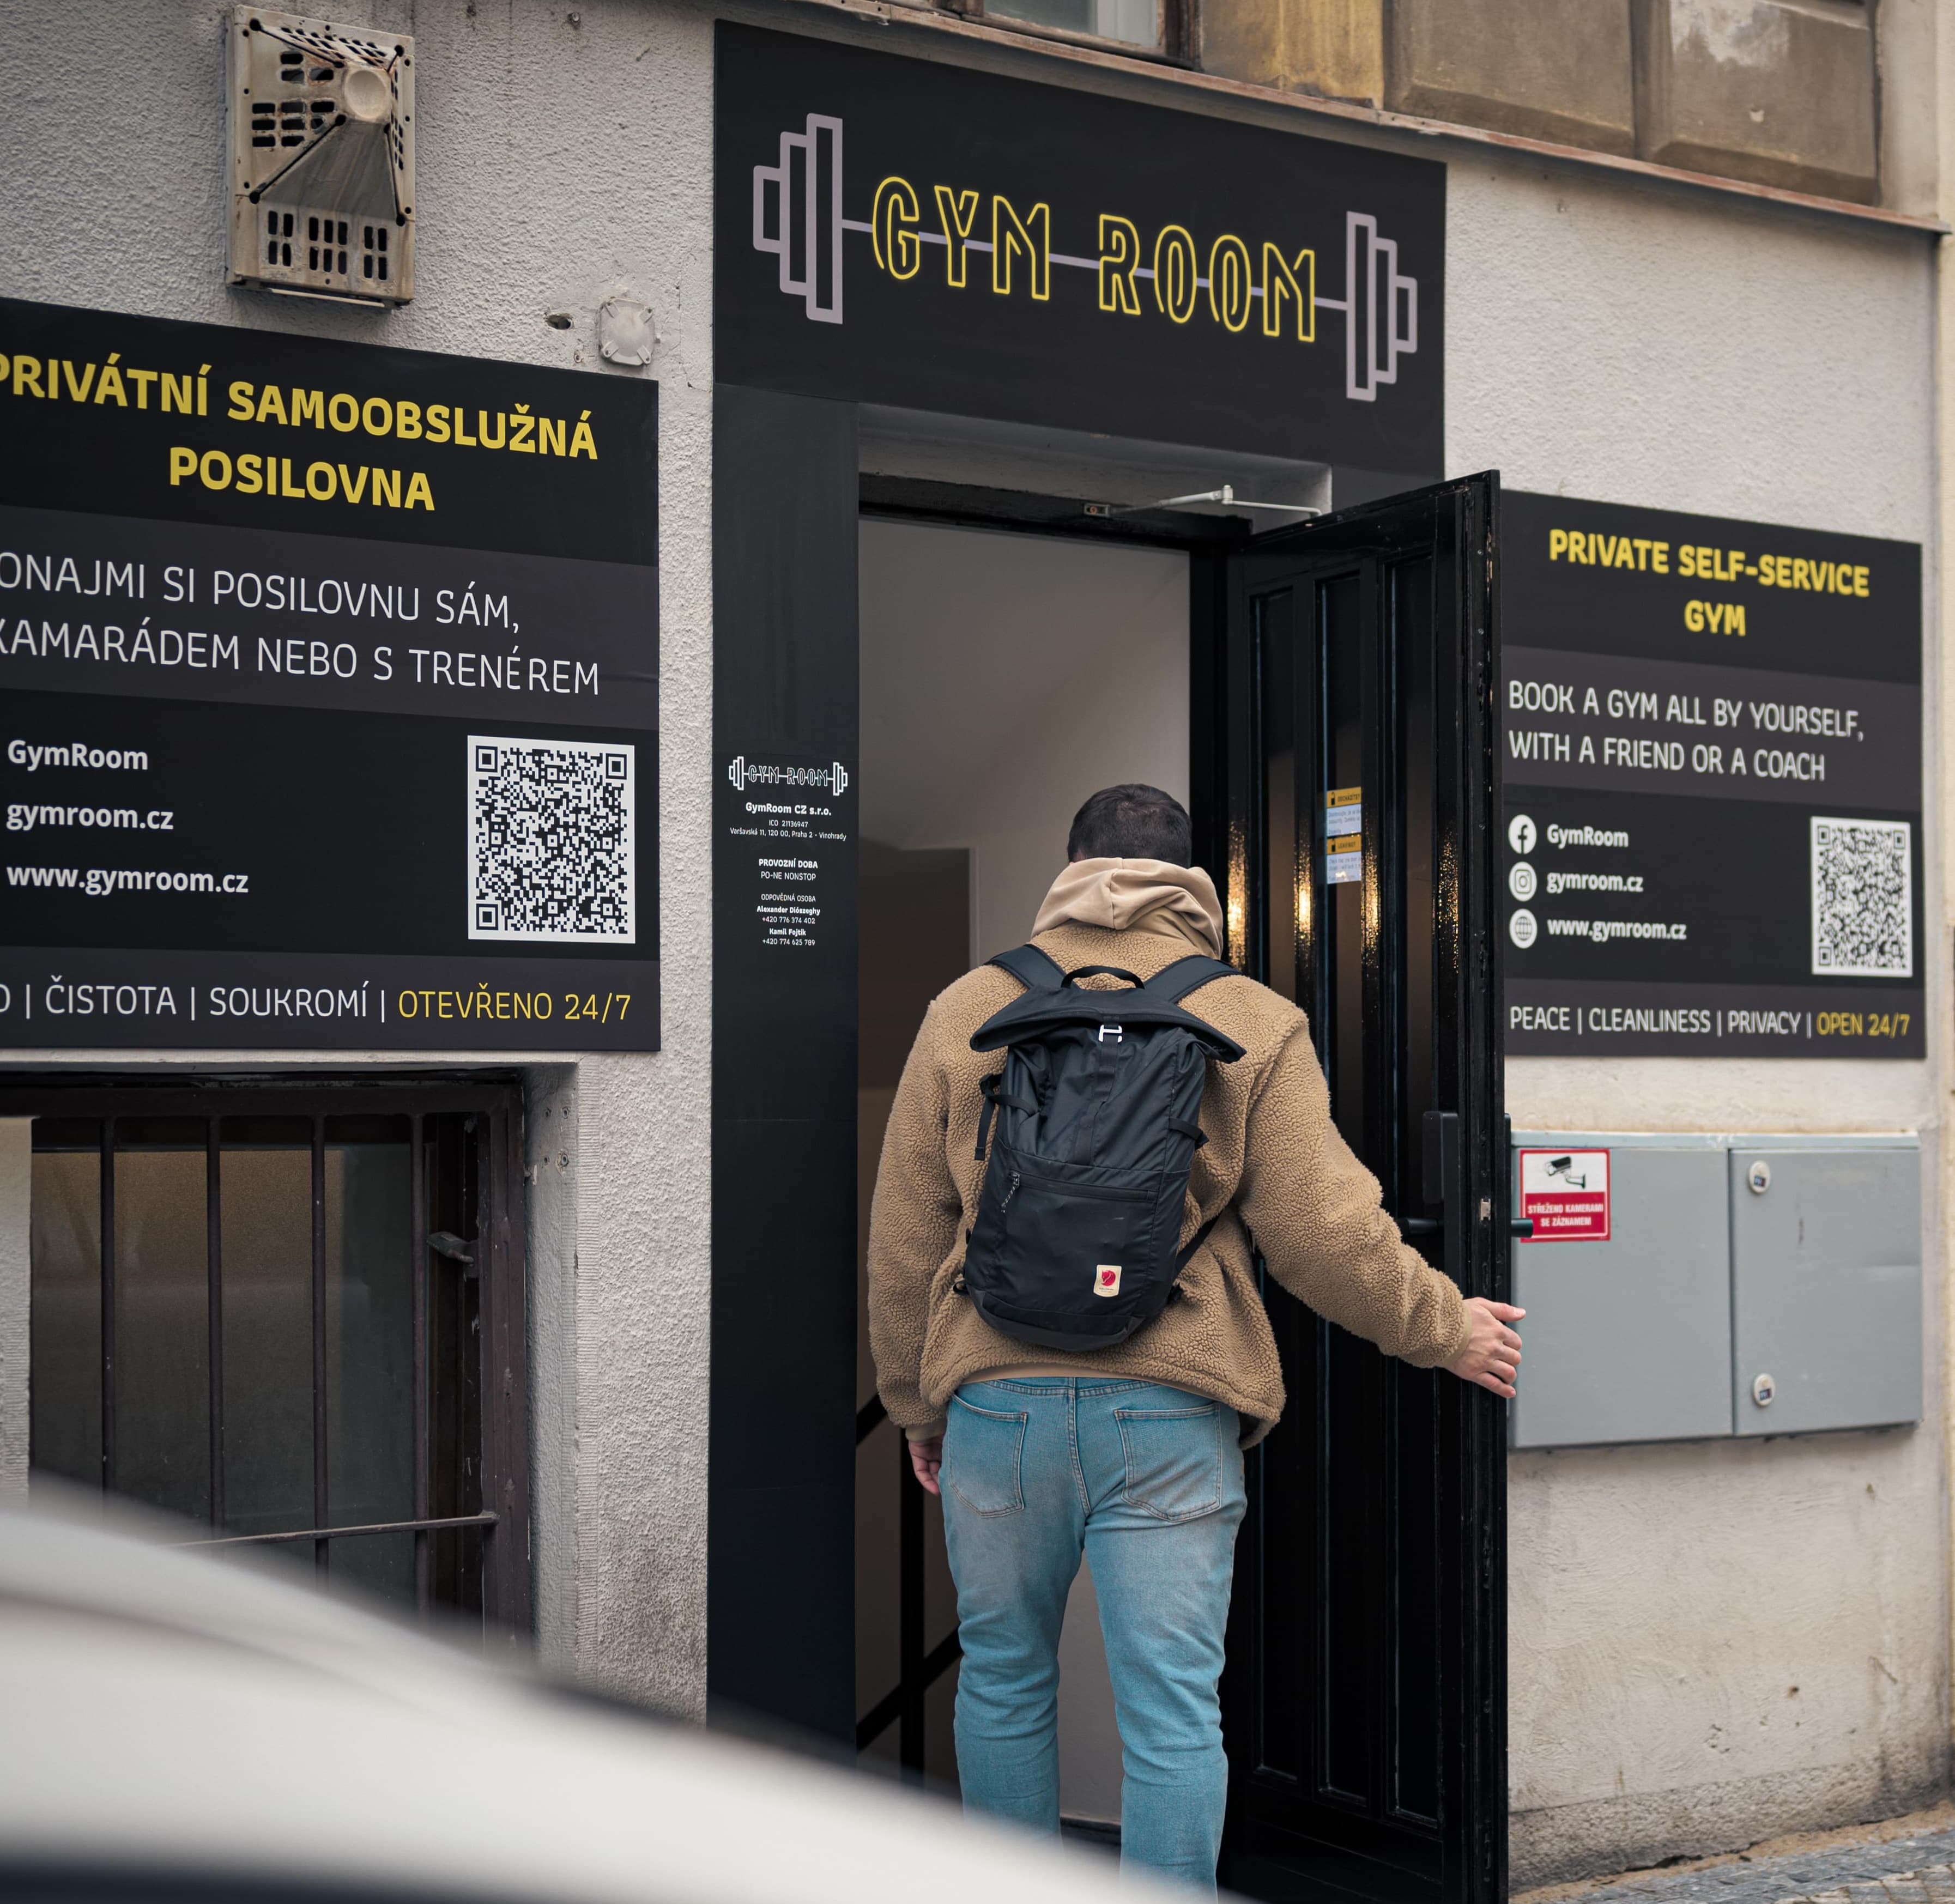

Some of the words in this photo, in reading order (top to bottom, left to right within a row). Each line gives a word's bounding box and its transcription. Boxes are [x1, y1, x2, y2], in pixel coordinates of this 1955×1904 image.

[872, 177, 1050, 301] GYM
[1099, 214, 1315, 342] ROOM
[228, 381, 597, 459] SAMOOBSLUŽNÁ
[171, 447, 434, 510] POSILOVNA
[1550, 529, 1669, 573] PRIVATE
[1679, 545, 1869, 597] SELF-SERVICE
[164, 567, 193, 602] SI
[214, 571, 418, 620] POSILOVNU
[437, 581, 518, 633] SÁM,
[1685, 601, 1745, 636] GYM
[258, 638, 356, 677] NEBO
[374, 647, 392, 680] S
[409, 646, 598, 695] TRENÉREM
[1510, 681, 1575, 713] BOOK
[1583, 688, 1599, 715] A
[1608, 689, 1657, 720] GYM
[1666, 695, 1706, 725] ALL
[1714, 699, 1742, 726] BY
[1750, 702, 1863, 741] YOURSELF,
[8, 740, 148, 771] GymRoom
[1509, 730, 1569, 761] WITH
[1579, 736, 1595, 763] A
[1604, 737, 1684, 770] FRIEND
[1692, 744, 1723, 773] OR
[1731, 748, 1746, 774] A
[1754, 749, 1824, 780] COACH
[748, 765, 779, 784] GYM
[787, 767, 828, 787] ROOM
[7, 804, 173, 831] gymroom.cz
[746, 802, 791, 814] GymRoom
[795, 805, 807, 814] CZ
[819, 833, 846, 841] Vinohrady
[1547, 824, 1628, 848] GymRoom
[759, 859, 796, 868] PROVOZNÍ
[785, 872, 816, 881] NONSTOP
[7, 868, 249, 895] www.gymroom.cz
[1547, 872, 1643, 894] gymroom.cz
[761, 893, 795, 901] ODPOVĚDNÁ
[1547, 920, 1686, 942] www.gymroom.cz
[46, 975, 176, 1014] ČISTOTA
[210, 981, 368, 1016] SOUKROMÍ
[400, 983, 552, 1019] OTEVŘENO
[565, 993, 630, 1023] 24/7
[1511, 1006, 1570, 1030] PEACE
[1589, 1008, 1710, 1033] CLEANLINESS
[1728, 1010, 1801, 1034] PRIVACY
[1817, 1012, 1862, 1035] OPEN
[1868, 1014, 1910, 1038] 24/7
[1528, 1202, 1564, 1214] STŘEŽENO
[1565, 1203, 1604, 1213] KAMERAMI
[1541, 1218, 1550, 1227] SE
[1552, 1217, 1591, 1226] ZÁZNAMEM
